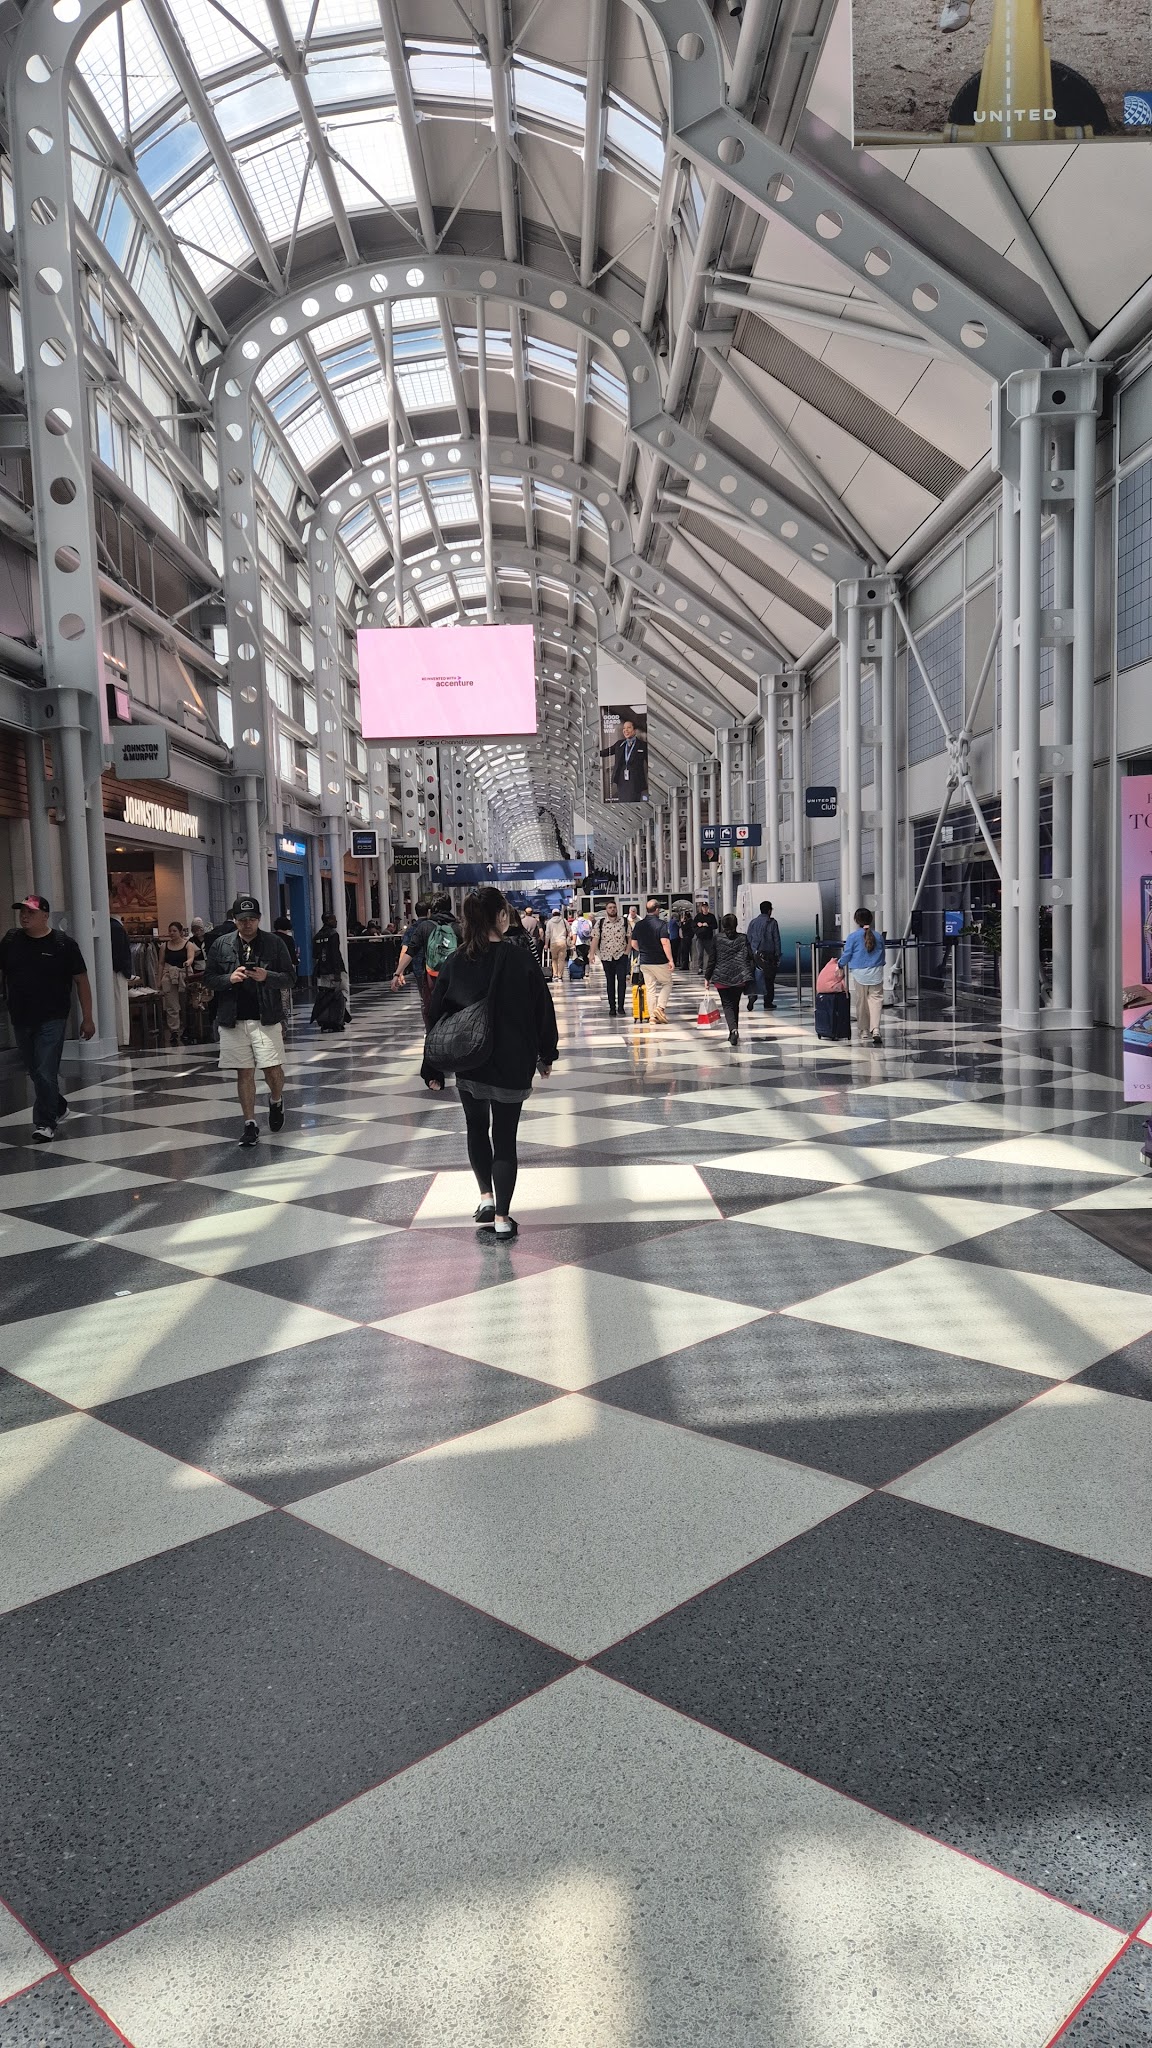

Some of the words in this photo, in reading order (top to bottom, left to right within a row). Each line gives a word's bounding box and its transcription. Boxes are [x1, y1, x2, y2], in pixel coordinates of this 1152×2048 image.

[973, 108, 1057, 123] UNITED
[122, 744, 158, 752] JOHNSTON
[821, 803, 836, 811] Club
[123, 795, 165, 831] JOHNSTON
[394, 858, 419, 866] PUCK
